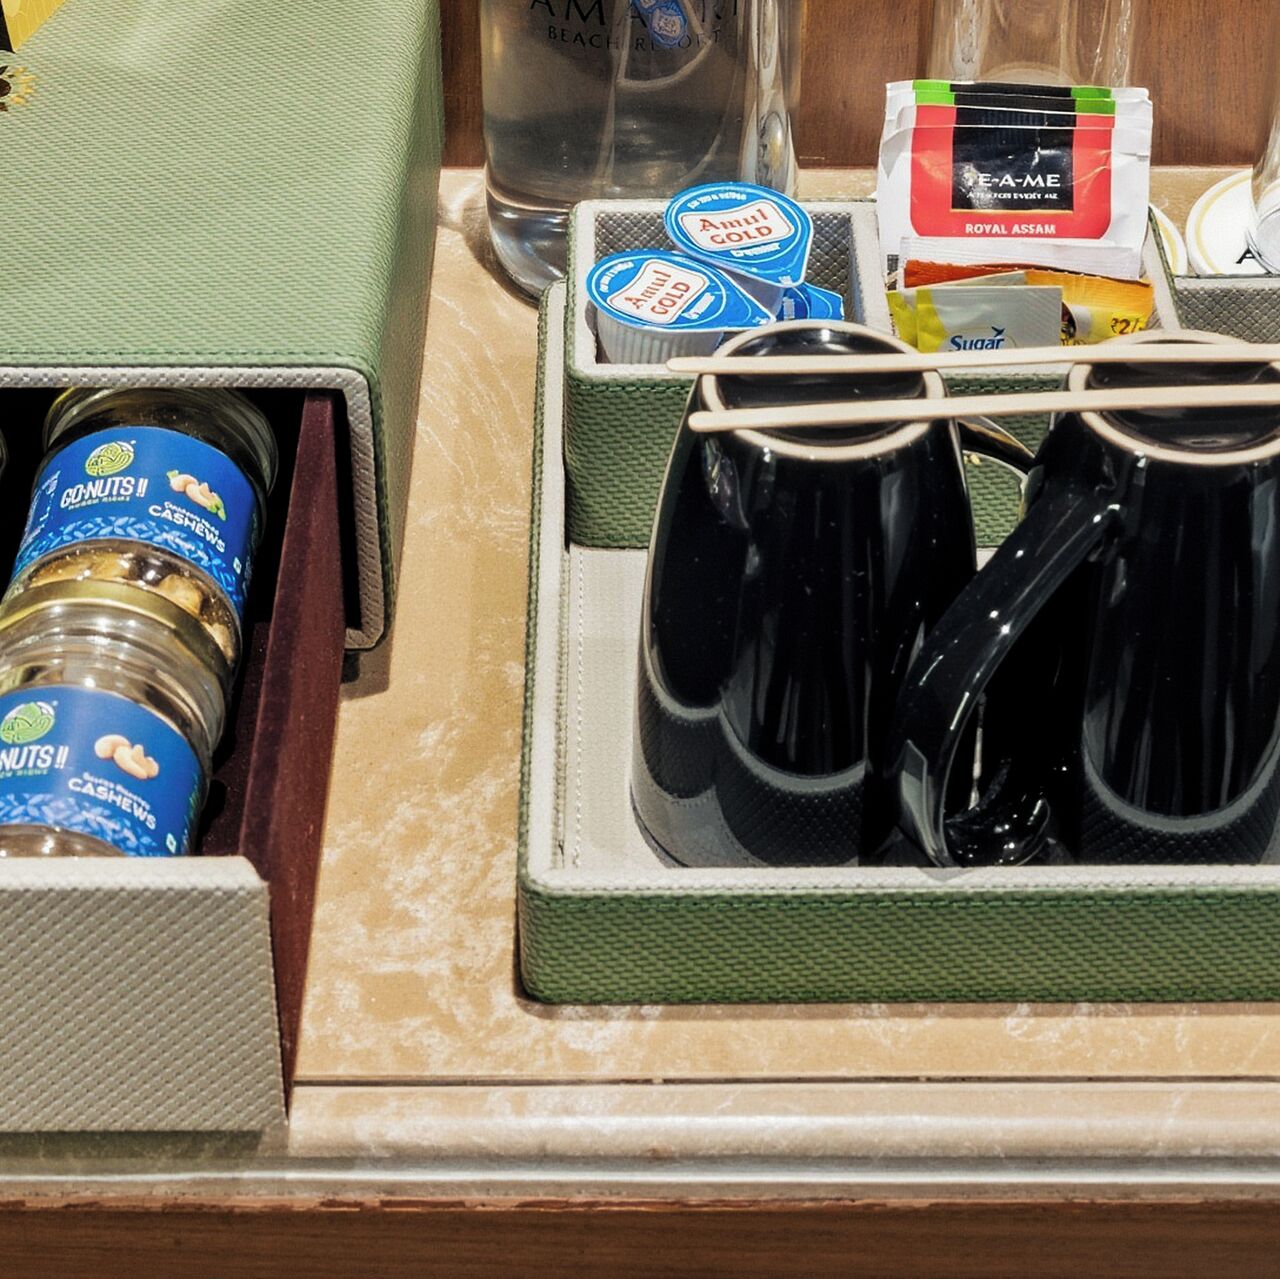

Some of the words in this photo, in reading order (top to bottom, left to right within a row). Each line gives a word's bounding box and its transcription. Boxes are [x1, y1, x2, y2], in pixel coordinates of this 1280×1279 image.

[699, 208, 768, 232] Amul
[965, 223, 1008, 235] ROYAL
[1012, 223, 1056, 235] ASSAM
[710, 225, 773, 245] GOLD
[624, 269, 672, 310] Amul
[650, 281, 690, 315] GOLD
[949, 334, 1005, 352] Sugar
[148, 504, 226, 553] CASHEWS
[68, 777, 157, 831] CASHEWS
